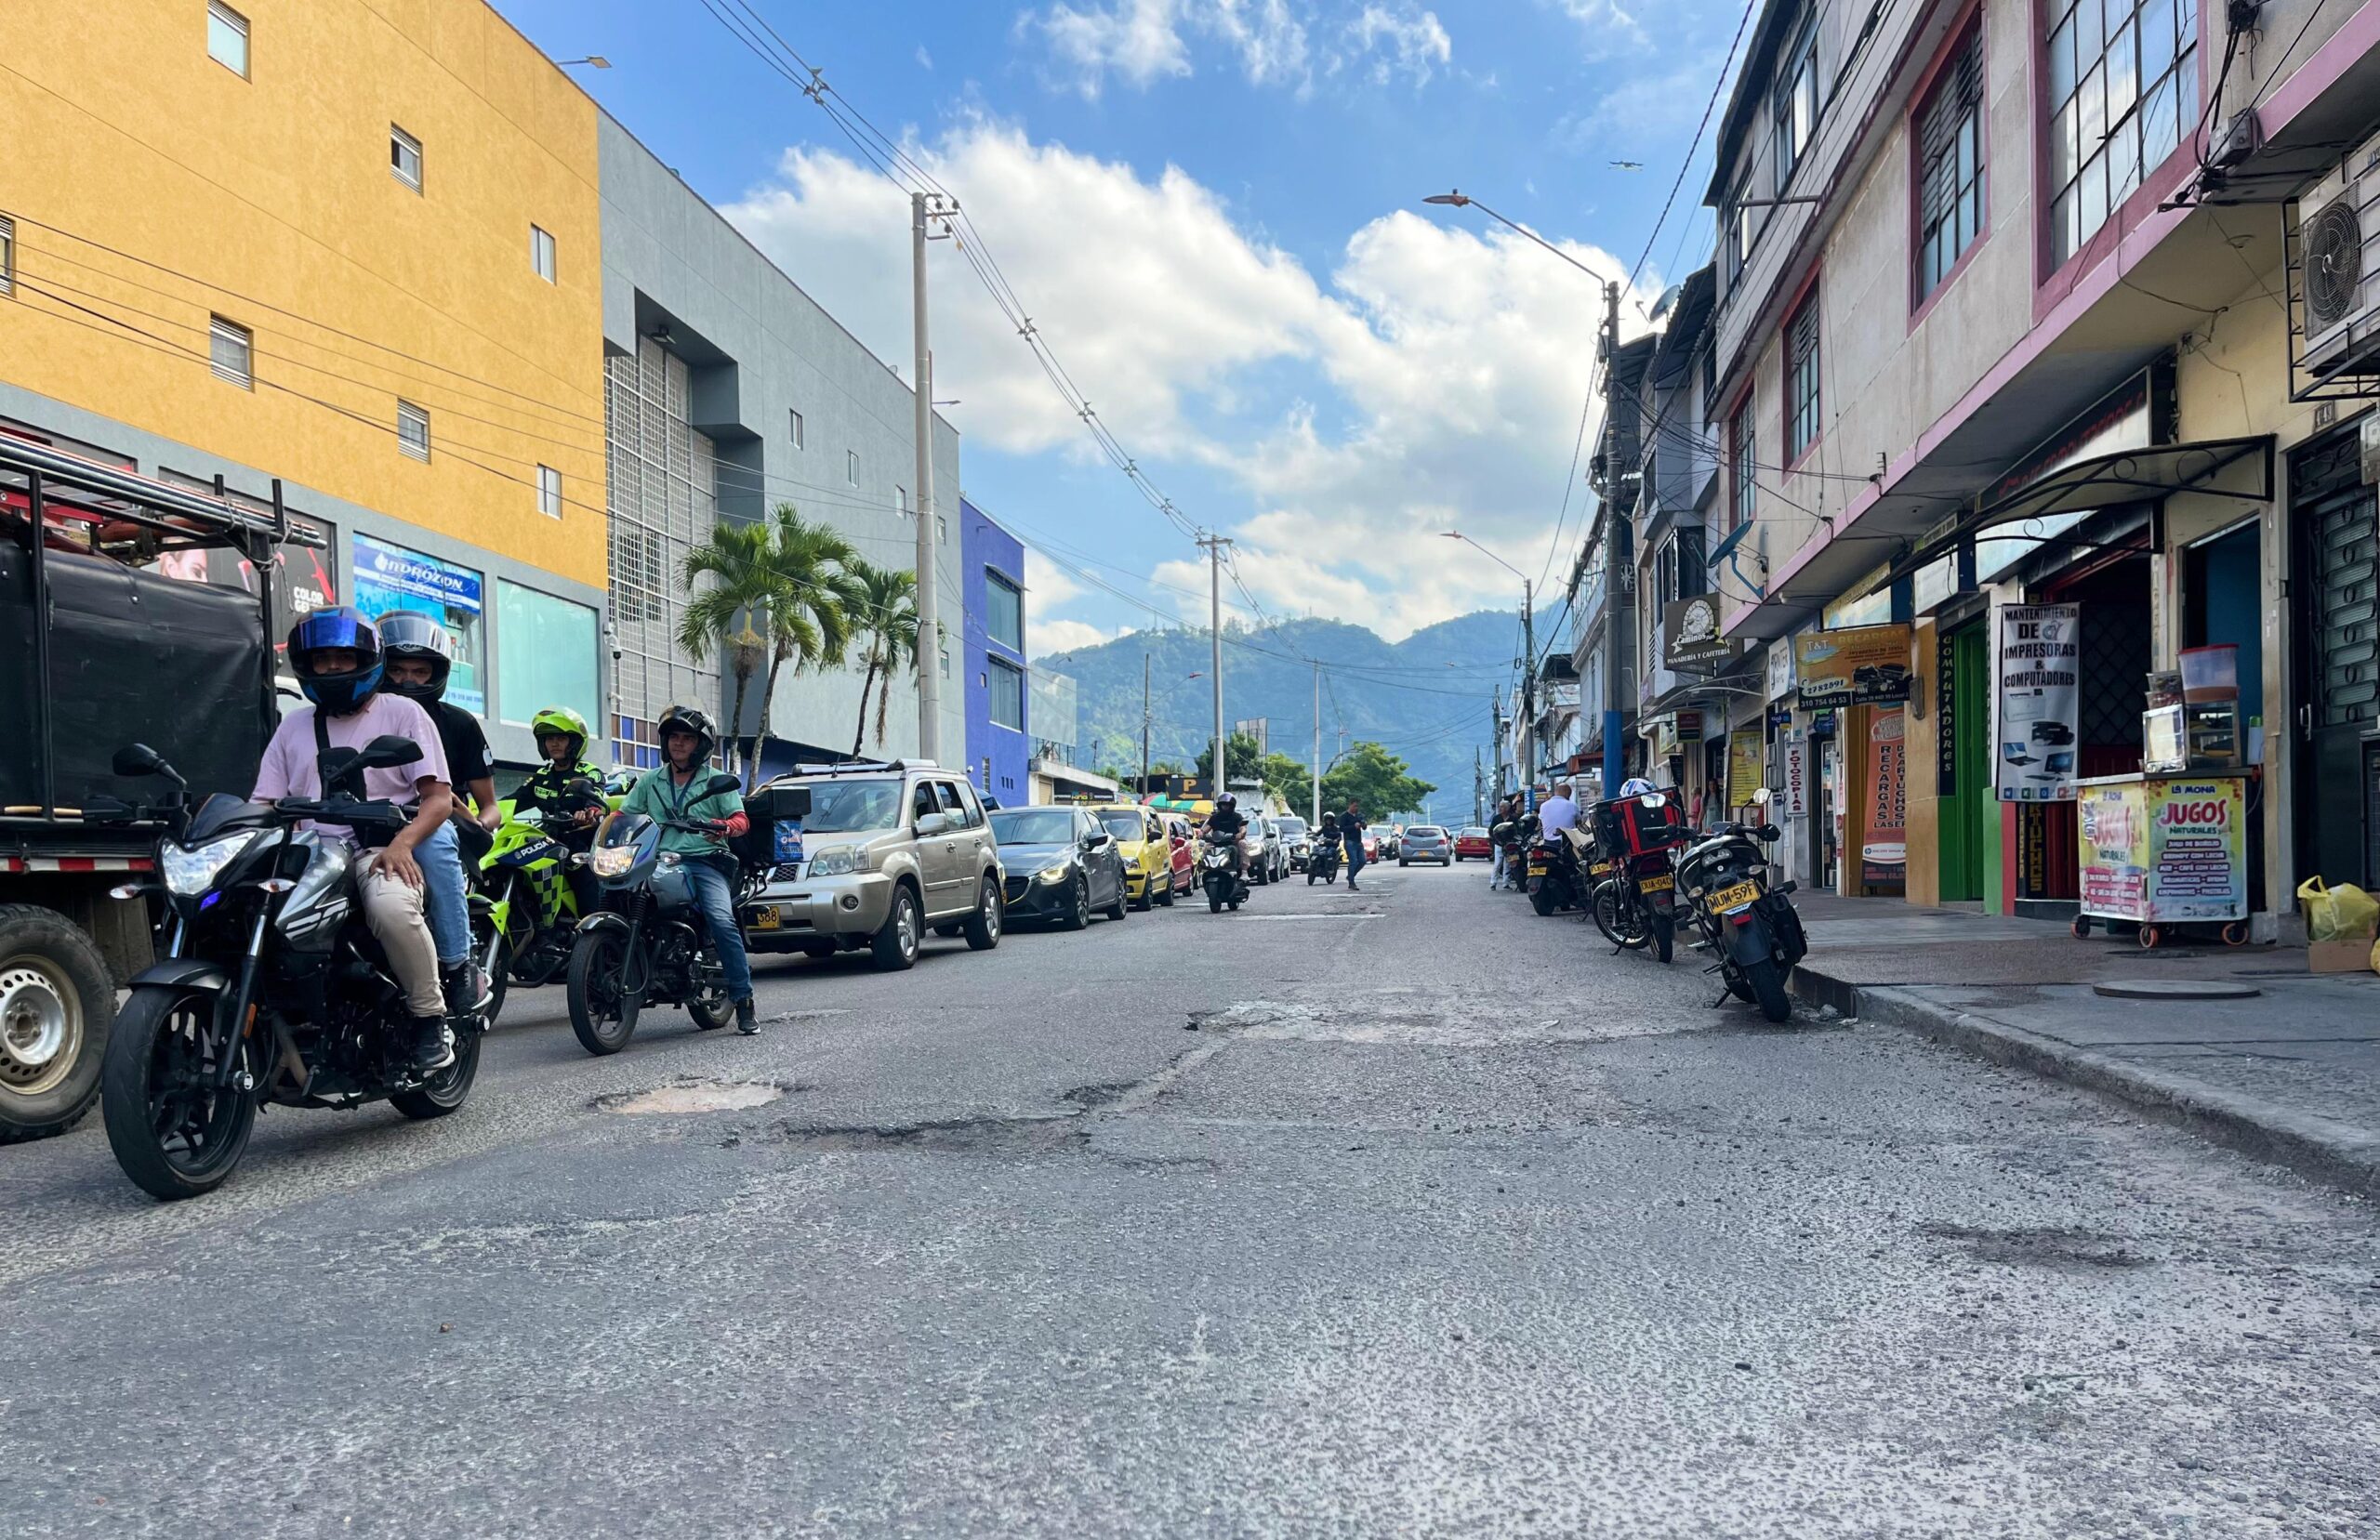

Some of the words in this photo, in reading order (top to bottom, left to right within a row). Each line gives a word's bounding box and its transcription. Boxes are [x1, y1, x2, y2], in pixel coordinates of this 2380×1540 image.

[294, 586, 324, 605] COLOR
[2004, 606, 2077, 621] MANTENIMIENTO
[2018, 623, 2039, 639] DE
[1806, 639, 1829, 652] T&T
[2004, 642, 2076, 659] IMPRESORAS
[2035, 660, 2043, 669] &
[2004, 671, 2075, 688] COMPUTADORES
[1183, 779, 1197, 792] P
[1790, 750, 1802, 811] FOTOCOPIAS
[1877, 745, 1892, 820] RECARGAS
[2171, 785, 2181, 794] LA
[2185, 785, 2215, 794] MONA
[2160, 799, 2227, 825] JUGOS
